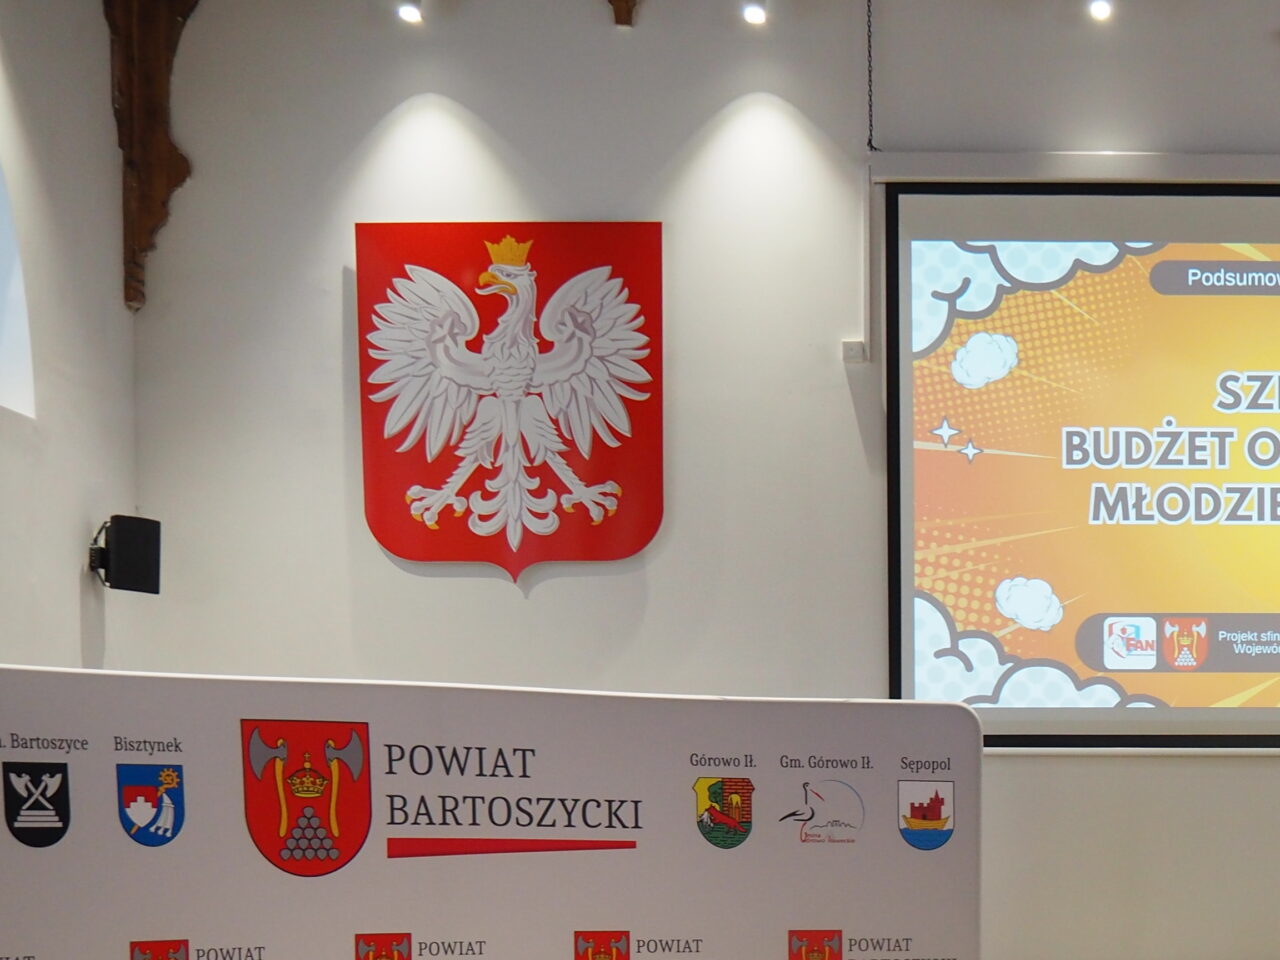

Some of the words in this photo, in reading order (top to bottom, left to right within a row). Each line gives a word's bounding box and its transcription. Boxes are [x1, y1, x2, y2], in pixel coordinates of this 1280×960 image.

[1062, 417, 1236, 470] BUDŻET
[1126, 638, 1155, 651] FAN
[1218, 630, 1258, 644] Projekt
[11, 733, 88, 754] Bartoszyce
[114, 736, 182, 755] Bisztynek
[384, 745, 535, 778] POWIAT
[690, 753, 739, 767] Górowo
[780, 755, 804, 768] Gm.
[809, 756, 857, 768] Górowo
[901, 757, 950, 773] Sępopol
[386, 795, 642, 829] BARTOSZYCKI
[419, 941, 485, 956] POWIAT
[637, 939, 702, 953] POWIAT
[848, 938, 912, 951] POWIAT
